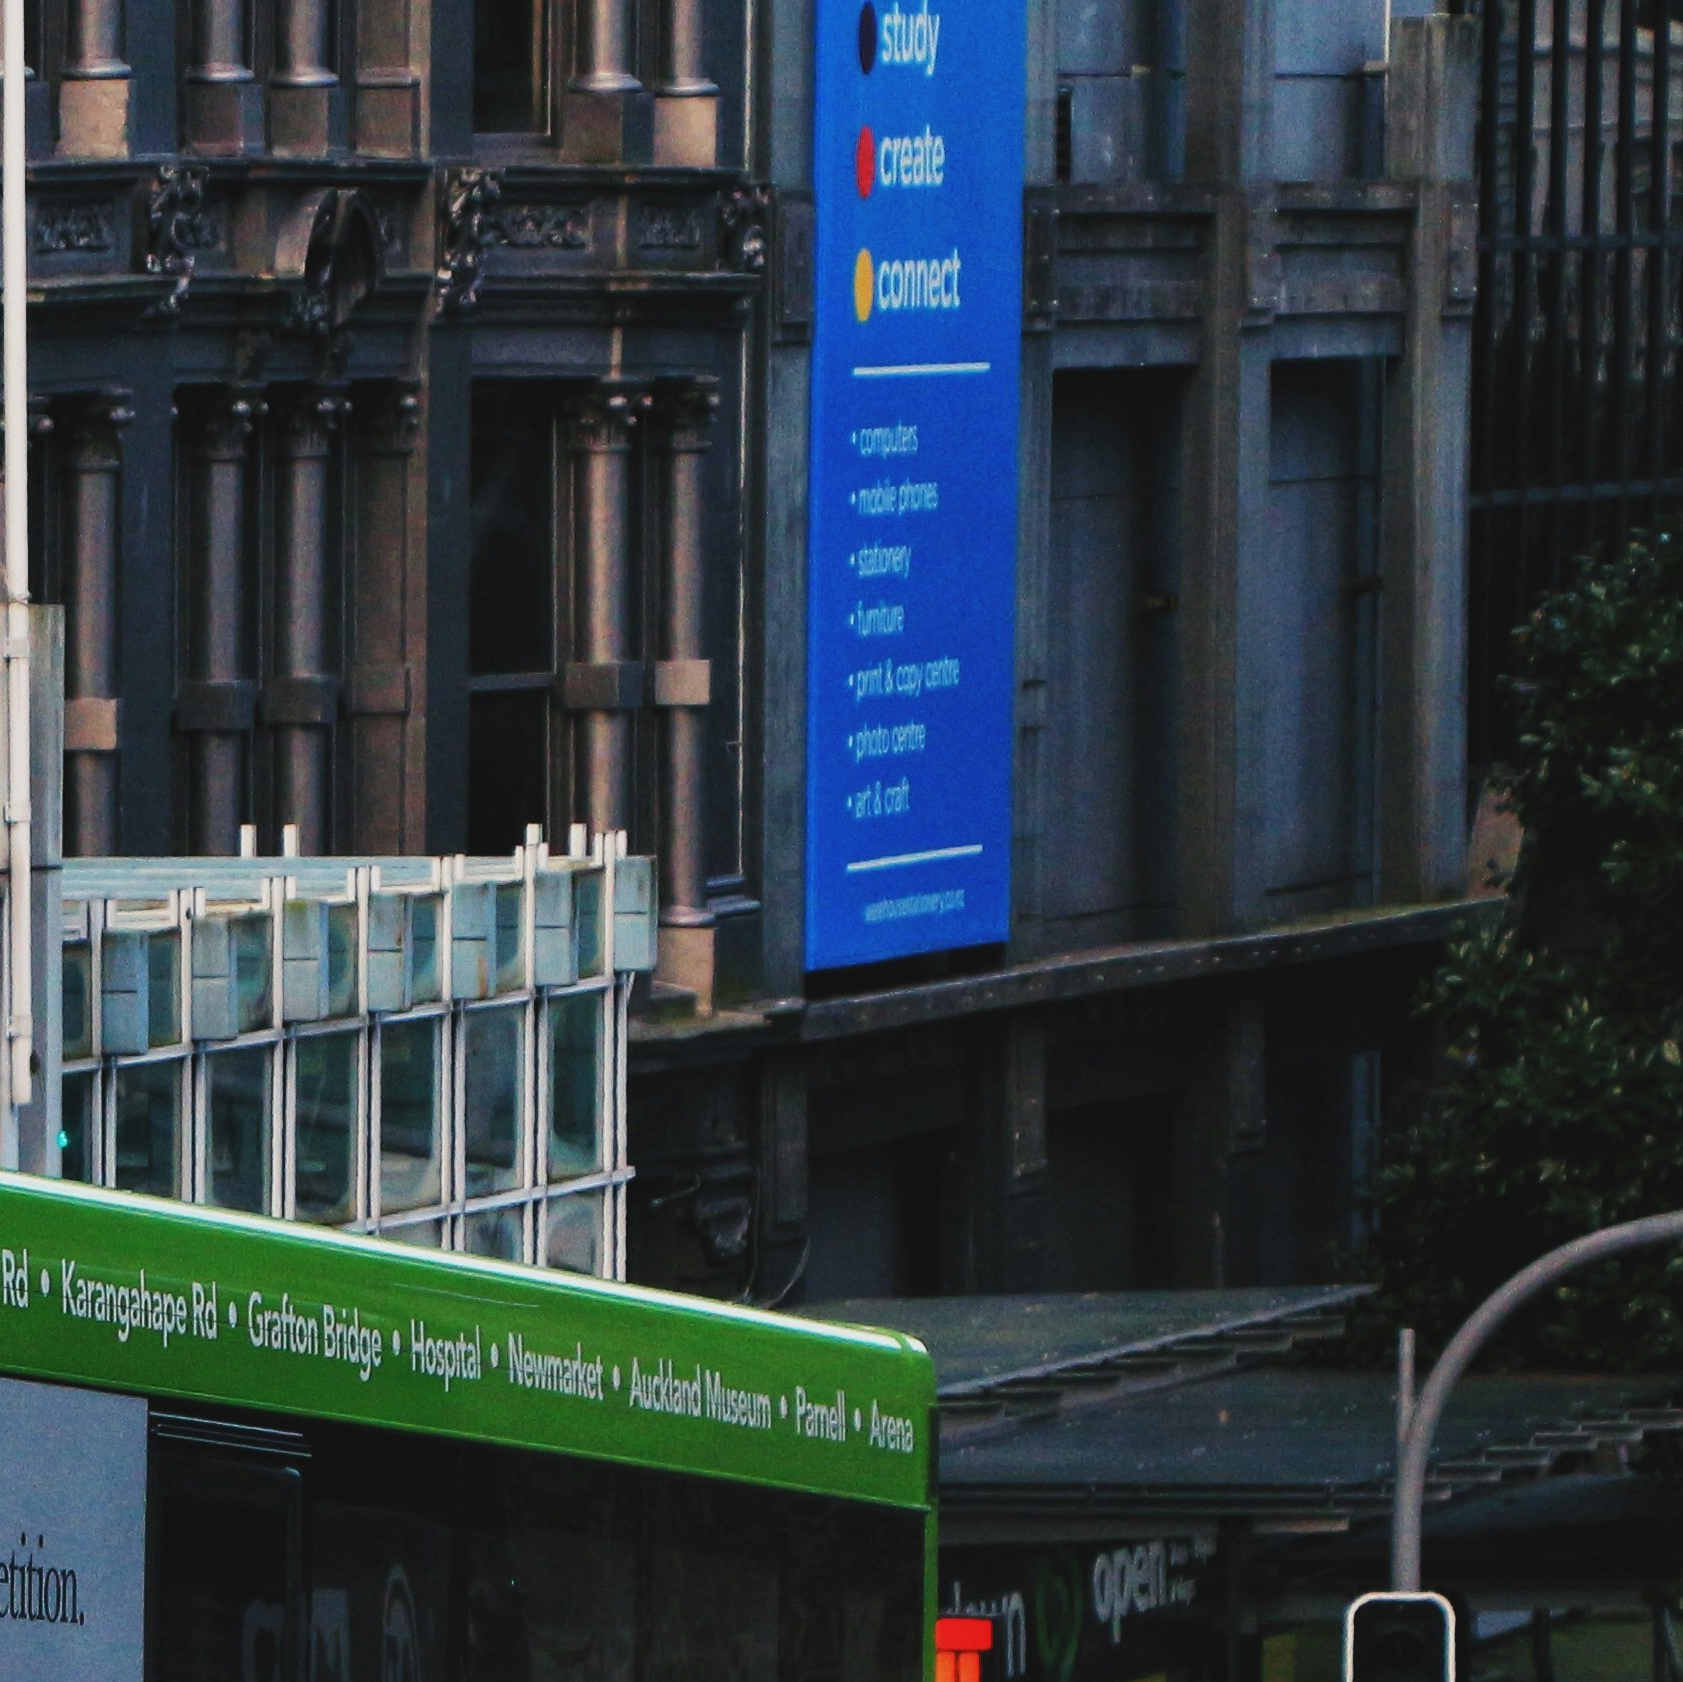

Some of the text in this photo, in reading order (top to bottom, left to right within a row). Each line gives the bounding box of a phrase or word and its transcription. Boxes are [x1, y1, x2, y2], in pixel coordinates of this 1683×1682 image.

[880, 0, 940, 76] study
[880, 124, 945, 186] create
[877, 246, 961, 309] connect
[860, 418, 919, 459] computers
[856, 661, 883, 701] print
[896, 663, 922, 697] copy
[856, 722, 890, 763] photo
[884, 776, 910, 814] craft
[2, 1248, 29, 1308] Rd
[61, 1257, 187, 1348] Karangahape
[191, 1280, 217, 1340] Rd
[247, 1291, 319, 1355] Grafton
[323, 1304, 382, 1382] Bridge
[410, 1318, 482, 1393] Hospital
[508, 1331, 604, 1401] Newmarket
[629, 1356, 702, 1418] Auckland
[705, 1368, 772, 1430] Museum
[795, 1385, 846, 1442] Parnell
[869, 1398, 914, 1455] Arena
[1093, 1539, 1167, 1646] open
